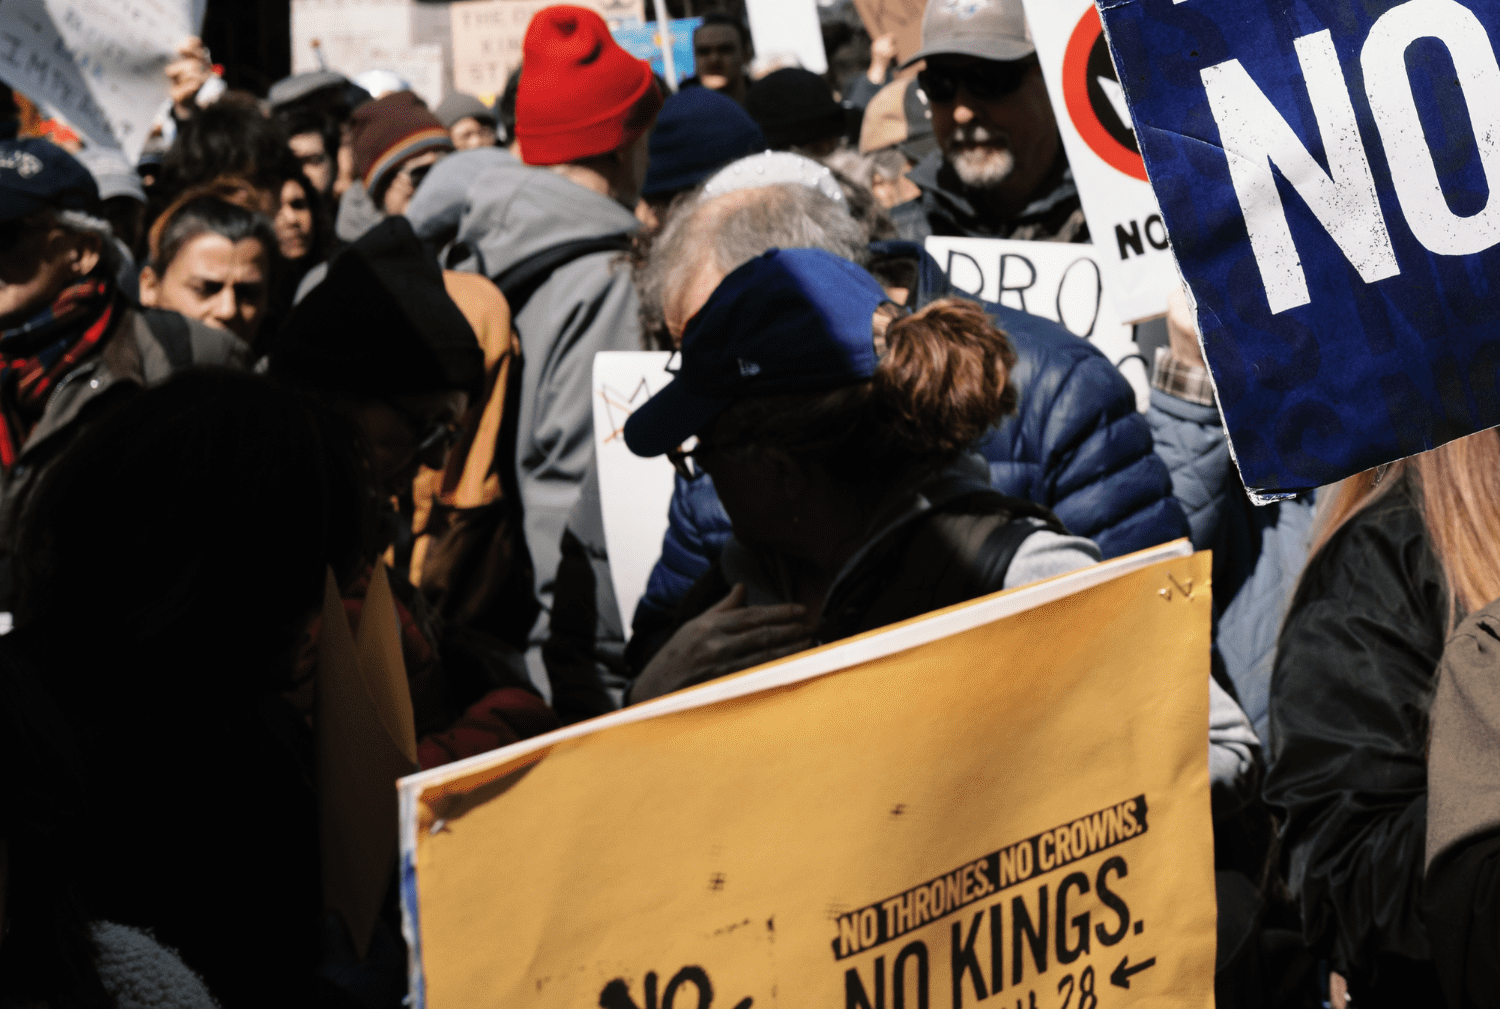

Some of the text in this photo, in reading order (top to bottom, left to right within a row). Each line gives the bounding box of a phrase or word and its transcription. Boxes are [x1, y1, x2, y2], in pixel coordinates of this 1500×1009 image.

[1115, 214, 1169, 260] NO
[838, 800, 1143, 957] NO THRONES. NO CROWNS.
[844, 855, 1144, 1009] NO KINGS.
